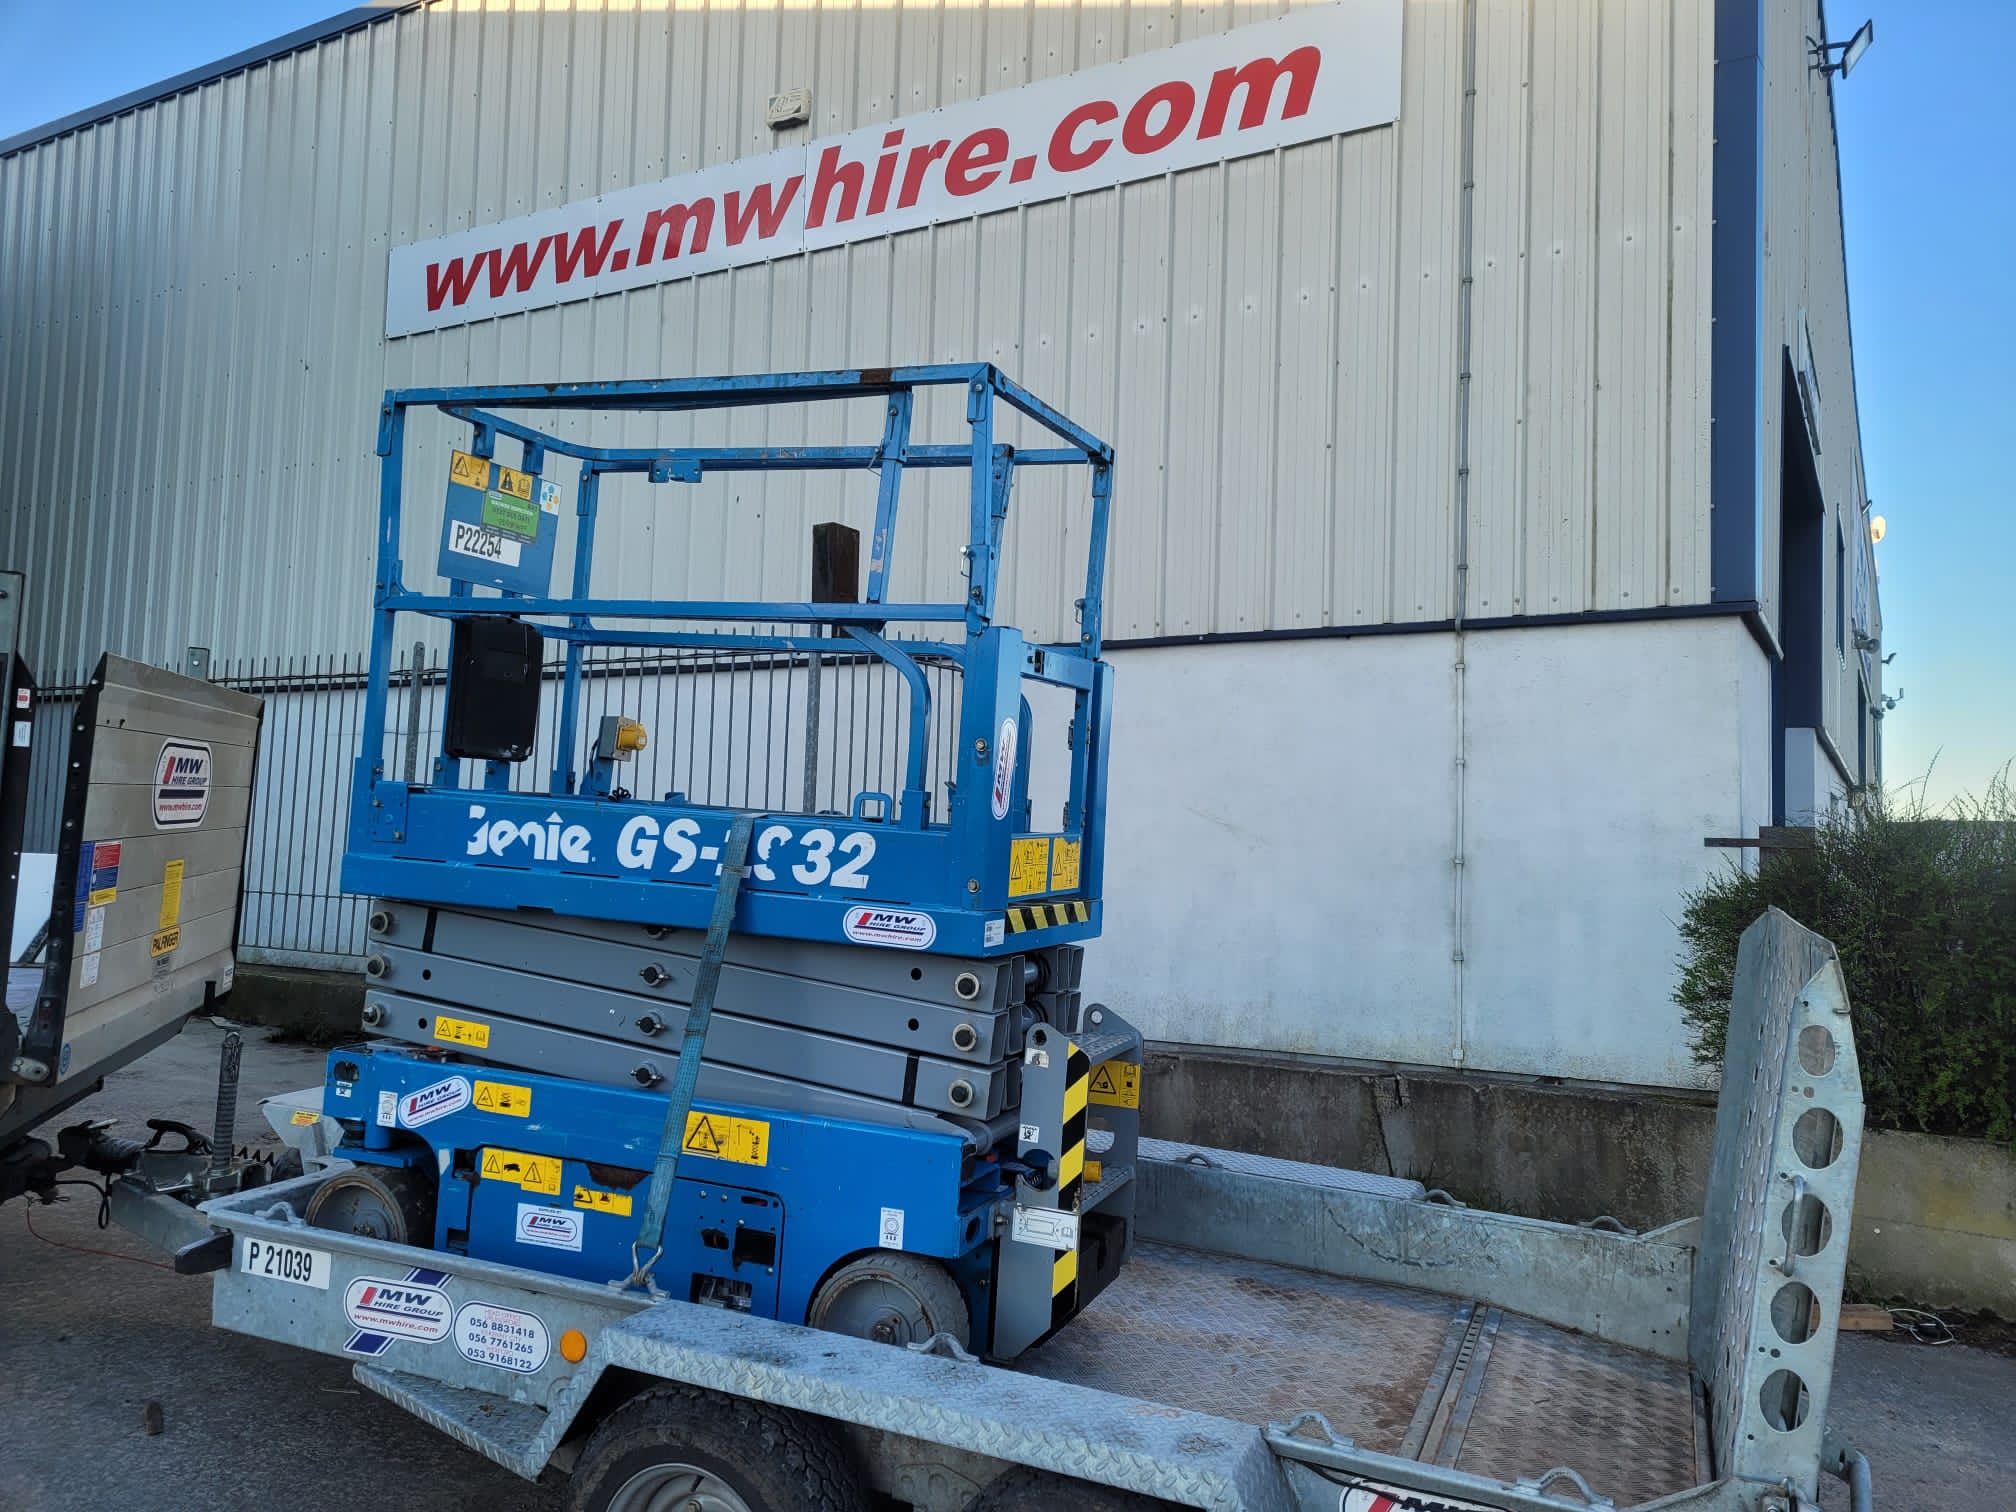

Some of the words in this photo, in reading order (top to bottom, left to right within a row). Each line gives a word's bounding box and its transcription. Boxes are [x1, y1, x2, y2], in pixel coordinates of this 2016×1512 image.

[426, 45, 1321, 312] www.mwhire.com
[454, 524, 502, 559] P22254
[175, 757, 204, 774] MW
[869, 921, 891, 929] HIRE
[874, 913, 917, 925] MW
[419, 1083, 452, 1102] MW
[539, 1217, 567, 1226] MW
[249, 1242, 260, 1270] P
[264, 1245, 312, 1281] 21039
[378, 1288, 432, 1306] MW
[374, 1301, 400, 1311] HIRE
[403, 1305, 444, 1317] GROUP
[354, 1313, 438, 1333] www.mwhire.com
[470, 1317, 488, 1329] 056
[491, 1321, 535, 1339] 8831418
[468, 1332, 487, 1344] 056
[490, 1336, 533, 1354] 7761265
[467, 1347, 486, 1359] 053
[488, 1352, 532, 1369] 9168122
